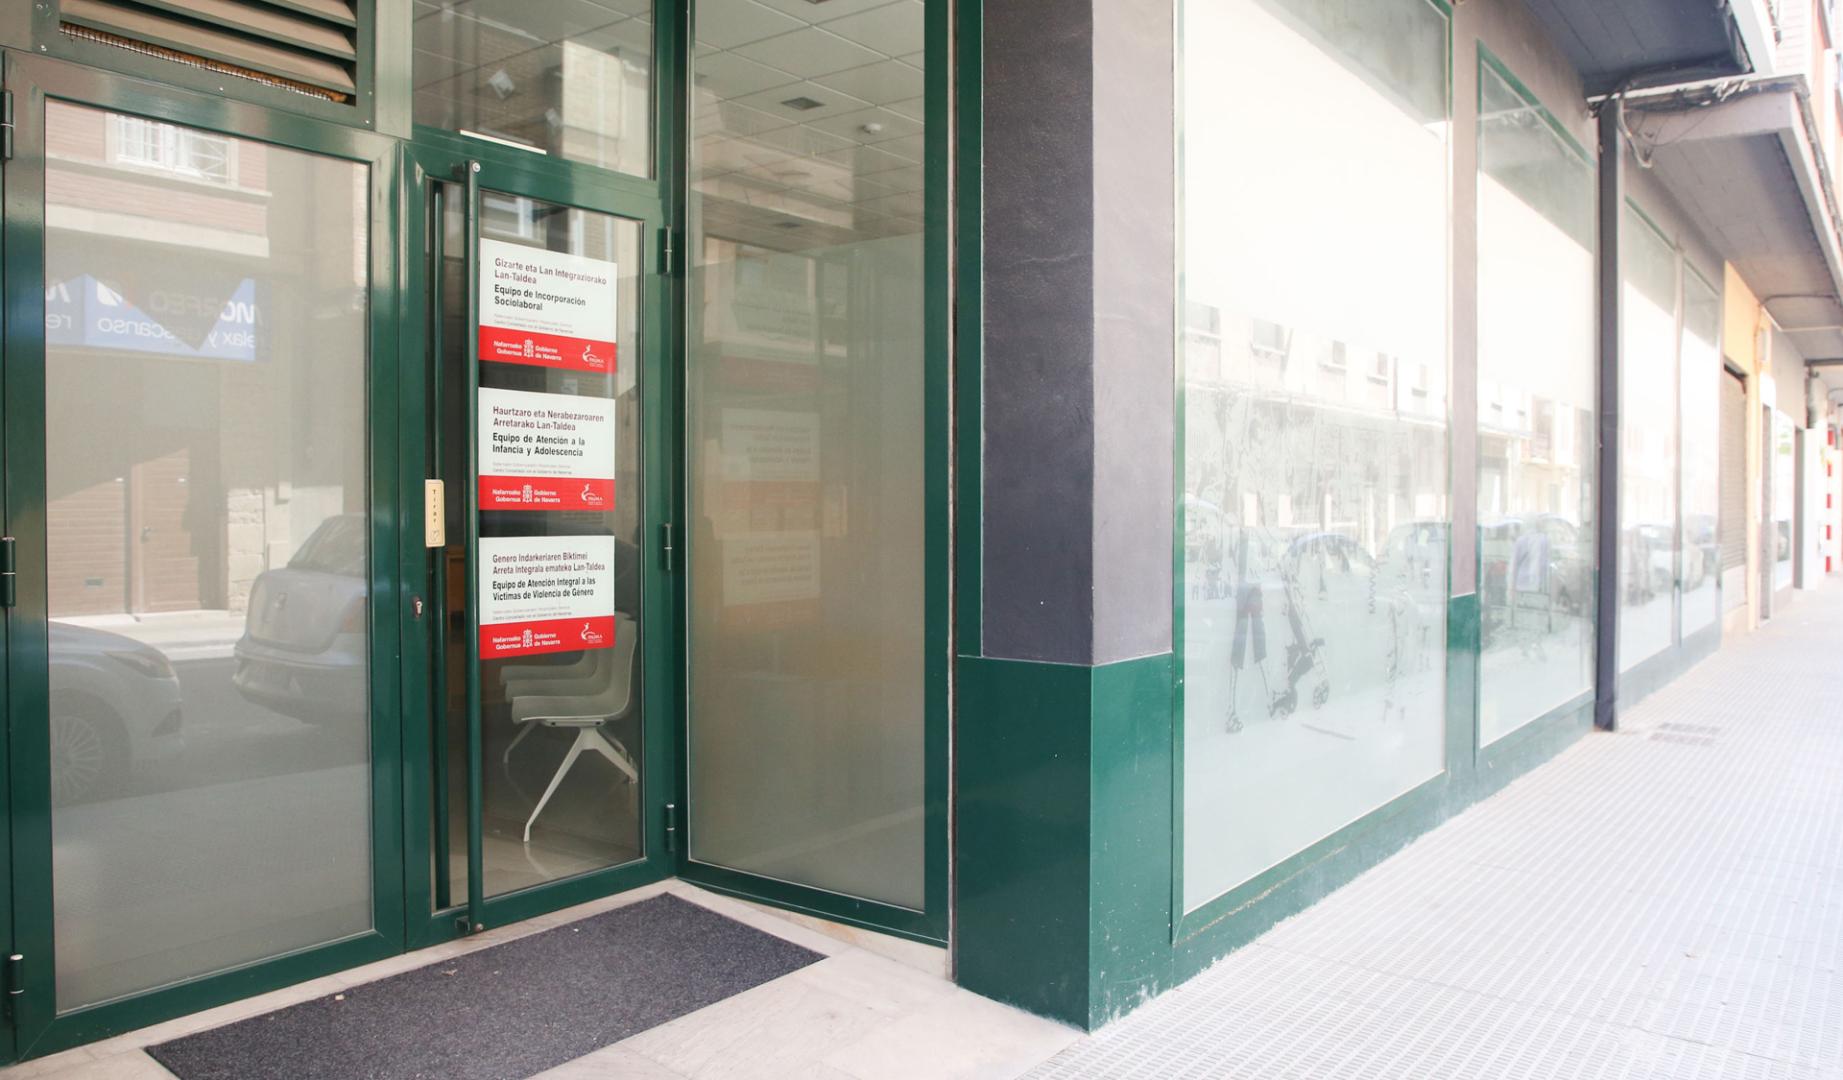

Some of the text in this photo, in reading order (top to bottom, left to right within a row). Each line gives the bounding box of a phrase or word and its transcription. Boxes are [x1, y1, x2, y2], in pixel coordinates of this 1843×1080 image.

[494, 257, 606, 285] Gizarte eta Lan Integraziorako
[494, 270, 536, 284] Lan-Taldea
[494, 284, 586, 306] Equipo de Incorporación
[494, 296, 542, 310] Sociolaboral
[492, 406, 604, 422] Haurtzaro eta Nerabezaroaren
[493, 418, 576, 431] Arretarako Lan-Taldea
[492, 432, 520, 444] Equipo
[524, 434, 533, 443] de
[578, 437, 586, 446] la
[492, 444, 584, 456] Infancia y Adolescencia
[492, 552, 588, 563] Genero Indarkeriaren Biktimei
[492, 566, 514, 574] Arreta
[545, 564, 572, 572] emateko
[574, 562, 605, 571] Lan-Taldea
[492, 580, 516, 590] Equipo
[517, 580, 526, 588] de
[528, 578, 555, 587] Atención
[557, 577, 580, 587] Integral
[523, 591, 532, 599] de
[532, 590, 561, 598] Violencia
[562, 588, 570, 596] de
